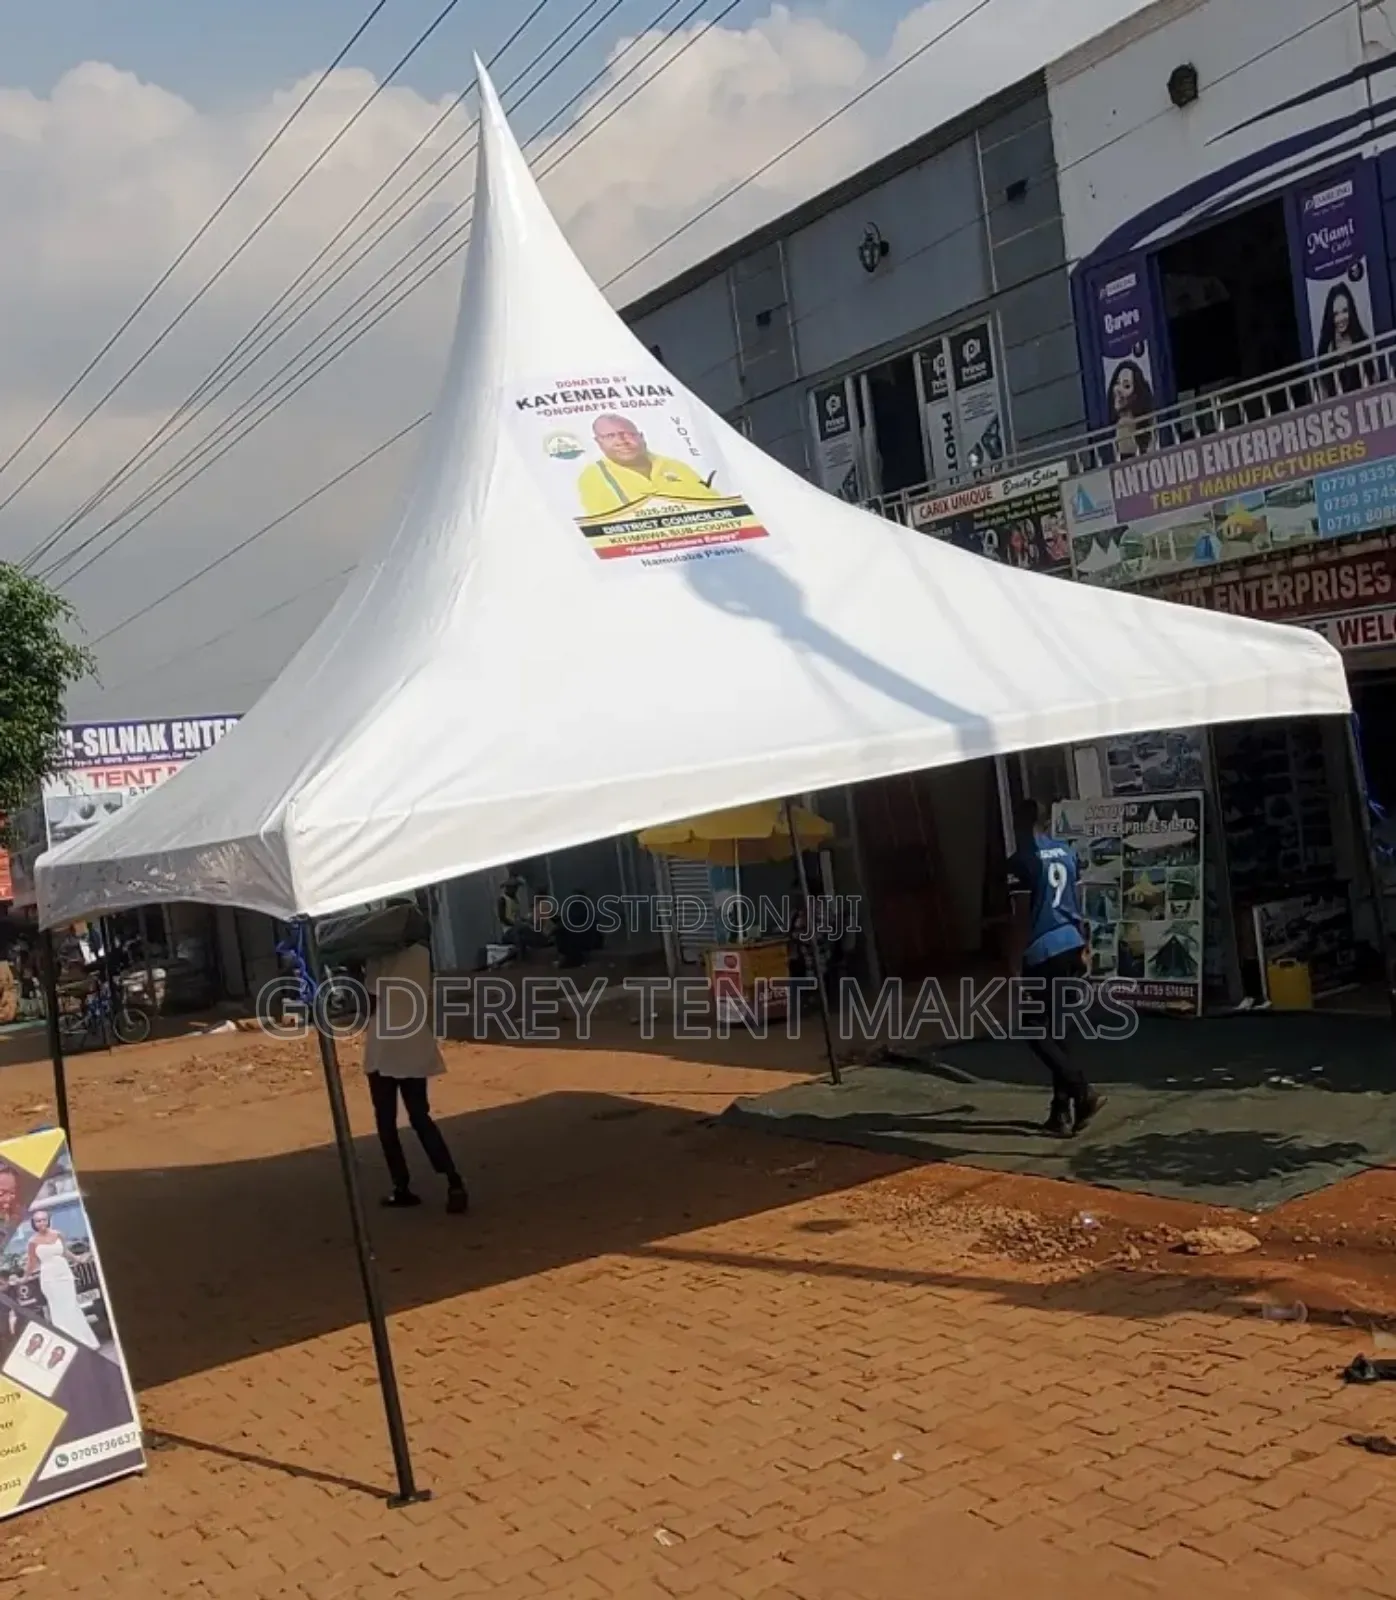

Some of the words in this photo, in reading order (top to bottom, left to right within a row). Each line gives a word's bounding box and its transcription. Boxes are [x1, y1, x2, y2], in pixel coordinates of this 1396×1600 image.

[1307, 217, 1355, 255] Miami
[516, 386, 622, 411] KAYEMBA
[624, 384, 675, 399] IVAN
[670, 416, 701, 456] VOTE
[1113, 449, 1198, 499] ANTOVID
[1202, 405, 1352, 475] ENTERPRISES
[1150, 484, 1194, 510] TENT
[1200, 439, 1368, 497] MANUFACTURERS
[951, 486, 993, 510] UNIQUE
[602, 517, 660, 536] DISTRICT
[1214, 560, 1392, 612] ENTERPRISES
[1337, 612, 1396, 646] WEL
[88, 768, 159, 791] TENT
[1048, 862, 1068, 908] 9
